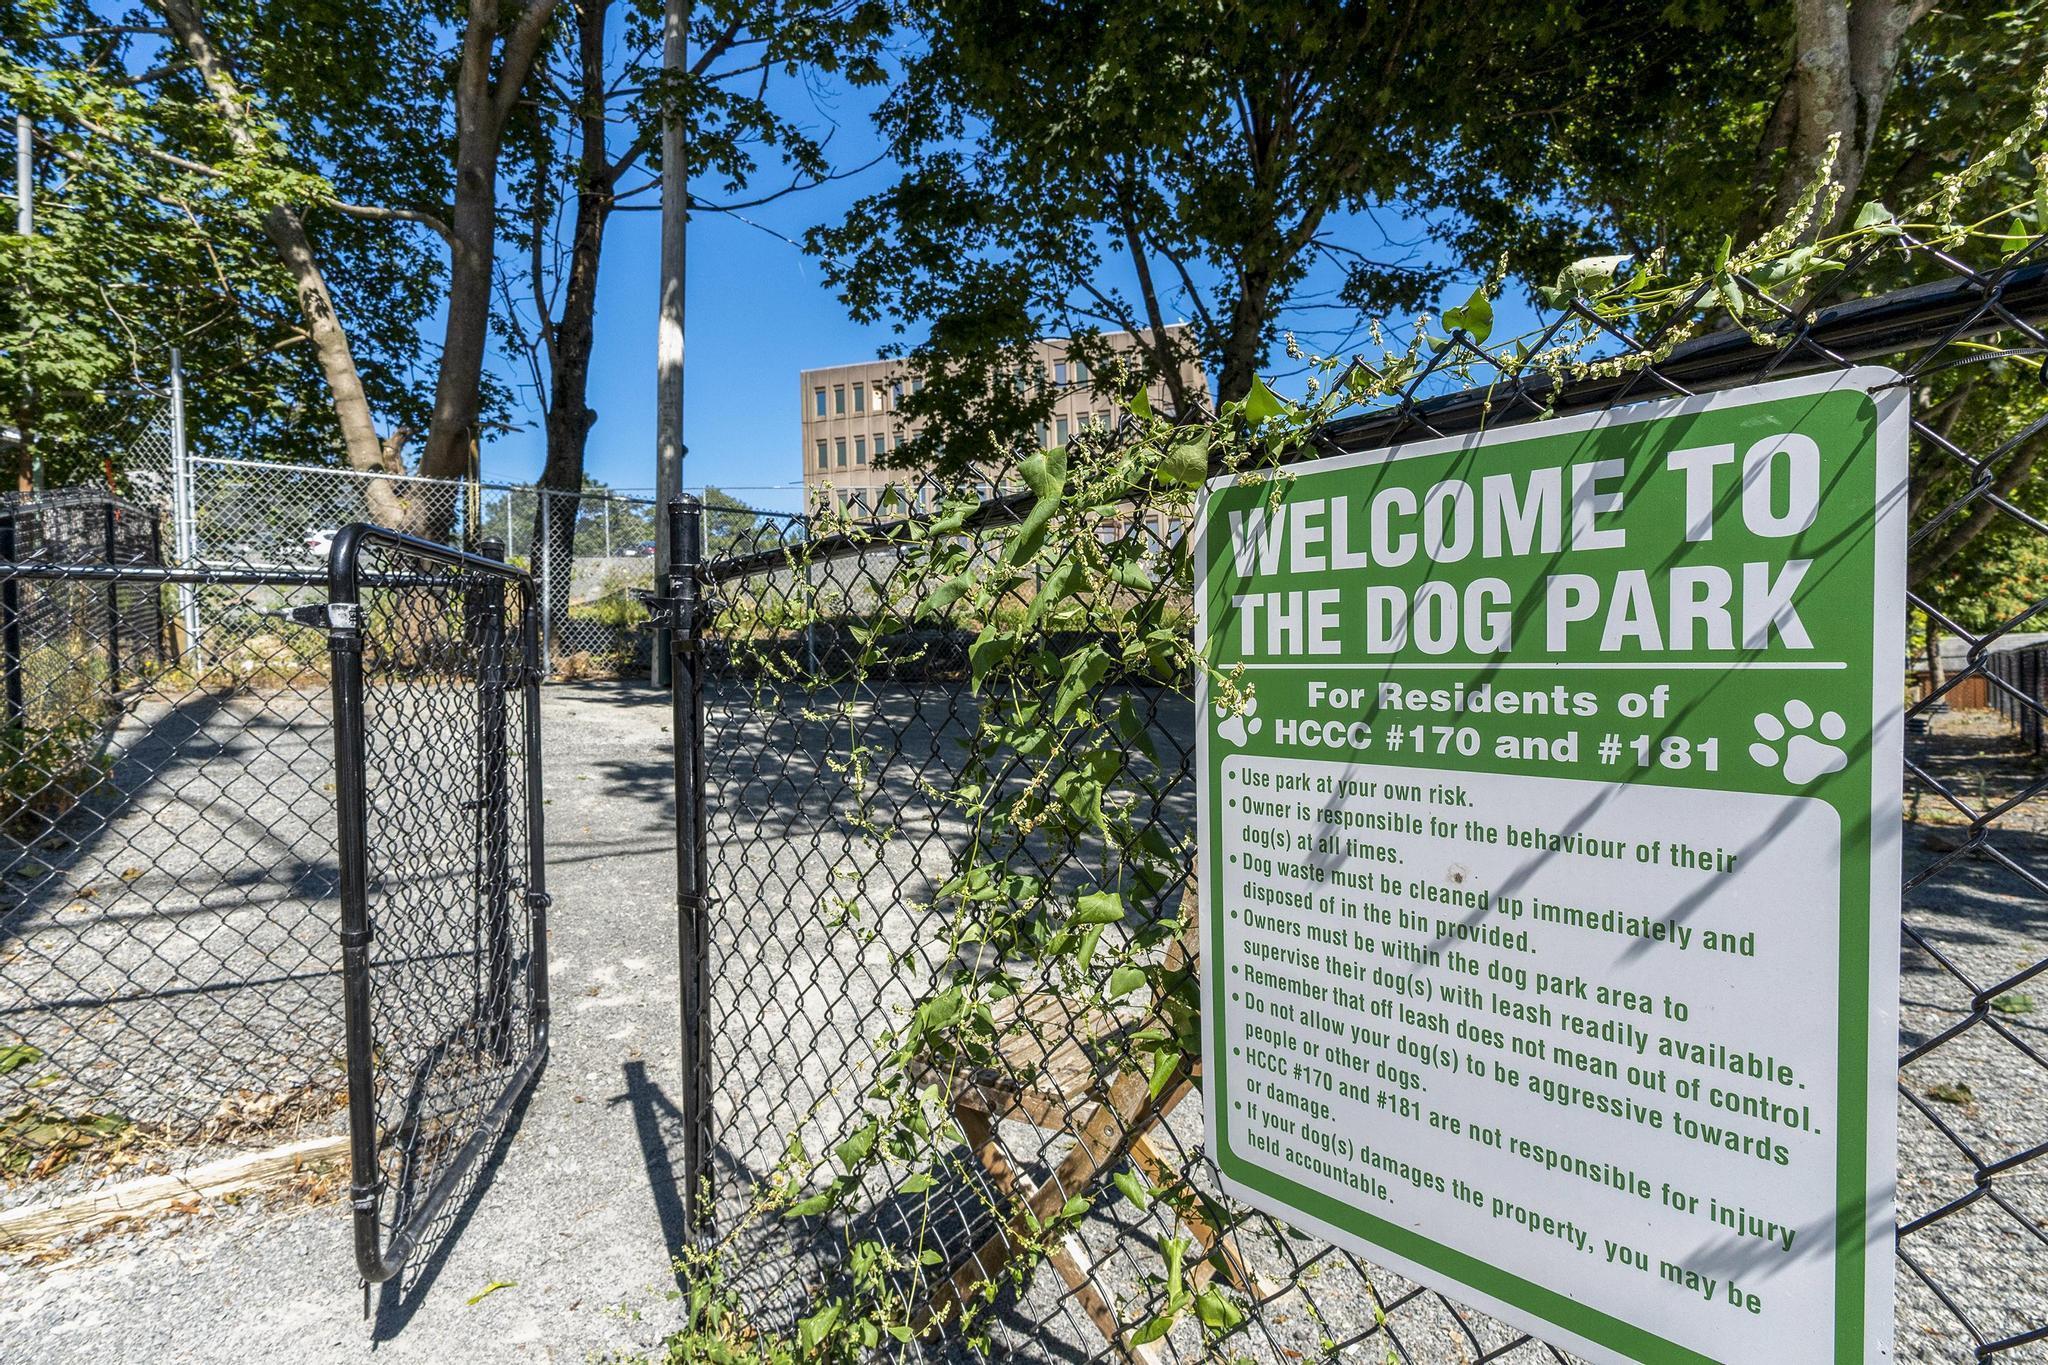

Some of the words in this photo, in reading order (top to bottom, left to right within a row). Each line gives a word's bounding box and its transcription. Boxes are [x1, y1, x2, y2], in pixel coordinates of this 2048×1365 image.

[1228, 457, 1627, 578] WELCOME
[1668, 434, 1820, 542] TO
[1232, 590, 1340, 655] THE
[1368, 579, 1512, 653] DOG
[1546, 560, 1812, 651] PARK
[1308, 681, 1365, 709] For
[1378, 683, 1599, 716] Residents
[1617, 684, 1670, 717] of
[1241, 767, 1270, 788] Use
[1275, 773, 1311, 793] park
[1316, 775, 1333, 794] at
[1338, 779, 1377, 801] your
[1384, 783, 1422, 803] own
[1429, 784, 1474, 807] risk.
[1275, 719, 1372, 750] HCCC
[1386, 723, 1481, 756] #170
[1495, 731, 1579, 762] and
[1597, 732, 1719, 771] #181
[1242, 795, 1291, 818] Owner
[1296, 805, 1311, 822] is
[1317, 808, 1423, 835] responsible
[1430, 816, 1458, 839] for
[1464, 820, 1498, 844] the
[1506, 825, 1627, 860] behaviour
[1635, 840, 1661, 865] of
[1670, 843, 1738, 874] their
[1242, 825, 1291, 851] dog(s)
[1297, 833, 1313, 851] at
[1319, 833, 1340, 854] all
[1346, 839, 1404, 865] times.
[1242, 851, 1272, 878] Dog
[1277, 861, 1325, 885] waste
[1329, 868, 1374, 892] must
[1380, 873, 1402, 896] be
[1409, 879, 1490, 913] cleaned
[1497, 896, 1523, 921] up
[1532, 898, 1693, 950] immediately
[1703, 930, 1755, 957] and
[1243, 880, 1313, 911] disposed
[1319, 895, 1335, 914] of
[1341, 897, 1357, 919] in
[1363, 903, 1392, 926] the
[1398, 908, 1428, 933] bin
[1435, 919, 1536, 954] provided.
[1243, 908, 1301, 938] Owners
[1307, 925, 1348, 948] must
[1354, 930, 1375, 954] be
[1381, 940, 1441, 968] within
[1447, 951, 1480, 977] the
[1487, 959, 1527, 992] dog
[1536, 972, 1588, 1001] park
[1596, 986, 1653, 1015] area
[1663, 995, 1689, 1023] to
[1243, 939, 1320, 971] supervise
[1325, 955, 1366, 982] their
[1372, 968, 1433, 1000] dog(s)
[1439, 985, 1483, 1010] with
[1492, 992, 1551, 1028] leash
[1561, 1014, 1649, 1055] readily
[1658, 1036, 1805, 1089] available.
[1244, 963, 1329, 1001] Remember
[1332, 986, 1366, 1013] that
[1370, 999, 1393, 1019] off
[1399, 1002, 1449, 1034] leash
[1456, 1018, 1505, 1050] does
[1511, 1036, 1546, 1060] not
[1553, 1047, 1618, 1080] mean
[1627, 1066, 1666, 1094] out
[1675, 1078, 1701, 1102] of
[1709, 1088, 1821, 1135] control.
[1245, 1023, 1297, 1052] people
[1302, 1040, 1320, 1058] or
[1325, 1047, 1369, 1073] other
[1376, 1060, 1427, 1092] dogs.
[1244, 991, 1265, 1014] Do
[1270, 1002, 1294, 1021] not
[1299, 1011, 1345, 1037] allow
[1351, 1024, 1391, 1048] your
[1396, 1035, 1459, 1073] dog(s)
[1466, 1053, 1486, 1078] to
[1494, 1063, 1520, 1087] be
[1528, 1075, 1663, 1129] aggressive
[1673, 1111, 1789, 1166] towards
[1247, 1077, 1262, 1094] or
[1266, 1082, 1336, 1122] damage.
[1246, 1046, 1288, 1077] HCCC
[1292, 1063, 1333, 1092] #170
[1338, 1081, 1370, 1105] and
[1376, 1089, 1420, 1121] #181
[1429, 1110, 1461, 1135] are
[1469, 1124, 1502, 1149] not
[1509, 1136, 1651, 1200] responsible
[1661, 1183, 1699, 1215] for
[1710, 1199, 1798, 1253] injury
[1247, 1127, 1280, 1158] held
[1285, 1147, 1394, 1204] accountable.
[1247, 1102, 1258, 1119] If
[1262, 1112, 1296, 1133] your
[1301, 1123, 1354, 1161] dog(s)
[1360, 1146, 1445, 1193] damages
[1451, 1178, 1484, 1208] the
[1492, 1198, 1594, 1254] property,
[1605, 1241, 1649, 1272] you
[1660, 1262, 1717, 1301] may
[1727, 1280, 1761, 1315] be
